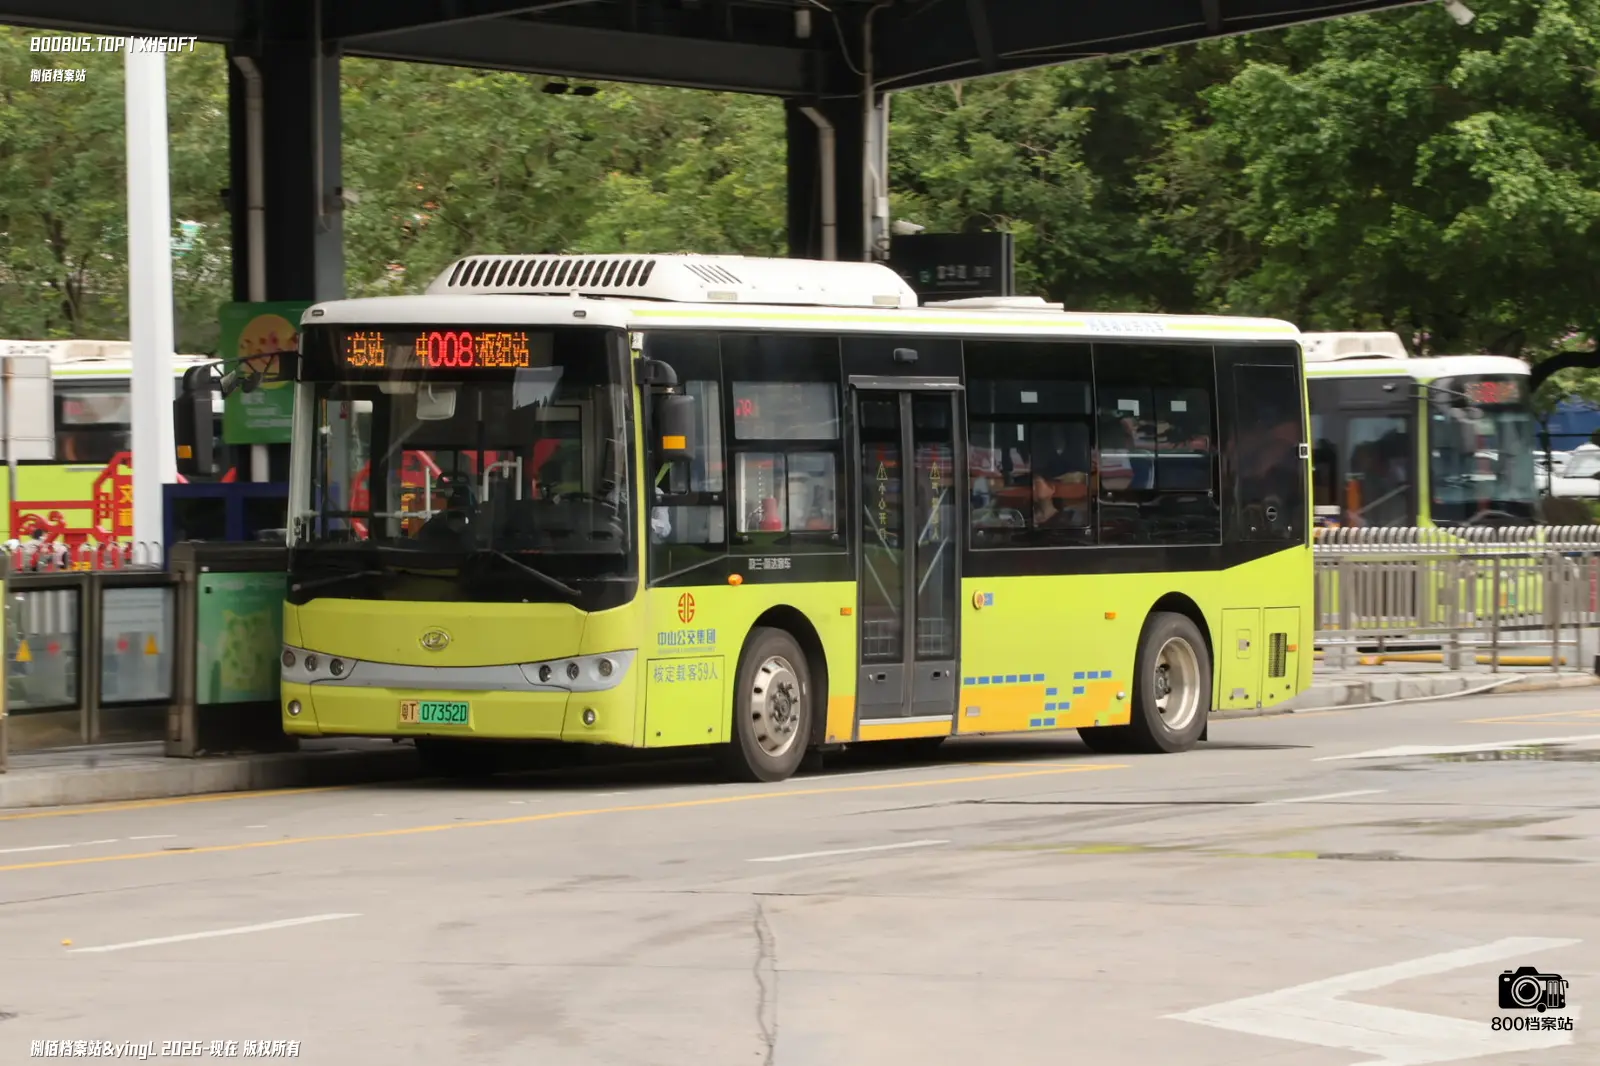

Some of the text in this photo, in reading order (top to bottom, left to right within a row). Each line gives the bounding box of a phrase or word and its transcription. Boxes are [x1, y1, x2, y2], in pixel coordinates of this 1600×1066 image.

[347, 331, 385, 367] 总站
[428, 331, 473, 367] 008
[475, 331, 529, 367] 枢纽站
[657, 628, 717, 646] 中山公交集团
[653, 662, 719, 683] 核定载客59人
[422, 703, 467, 722] 07352D
